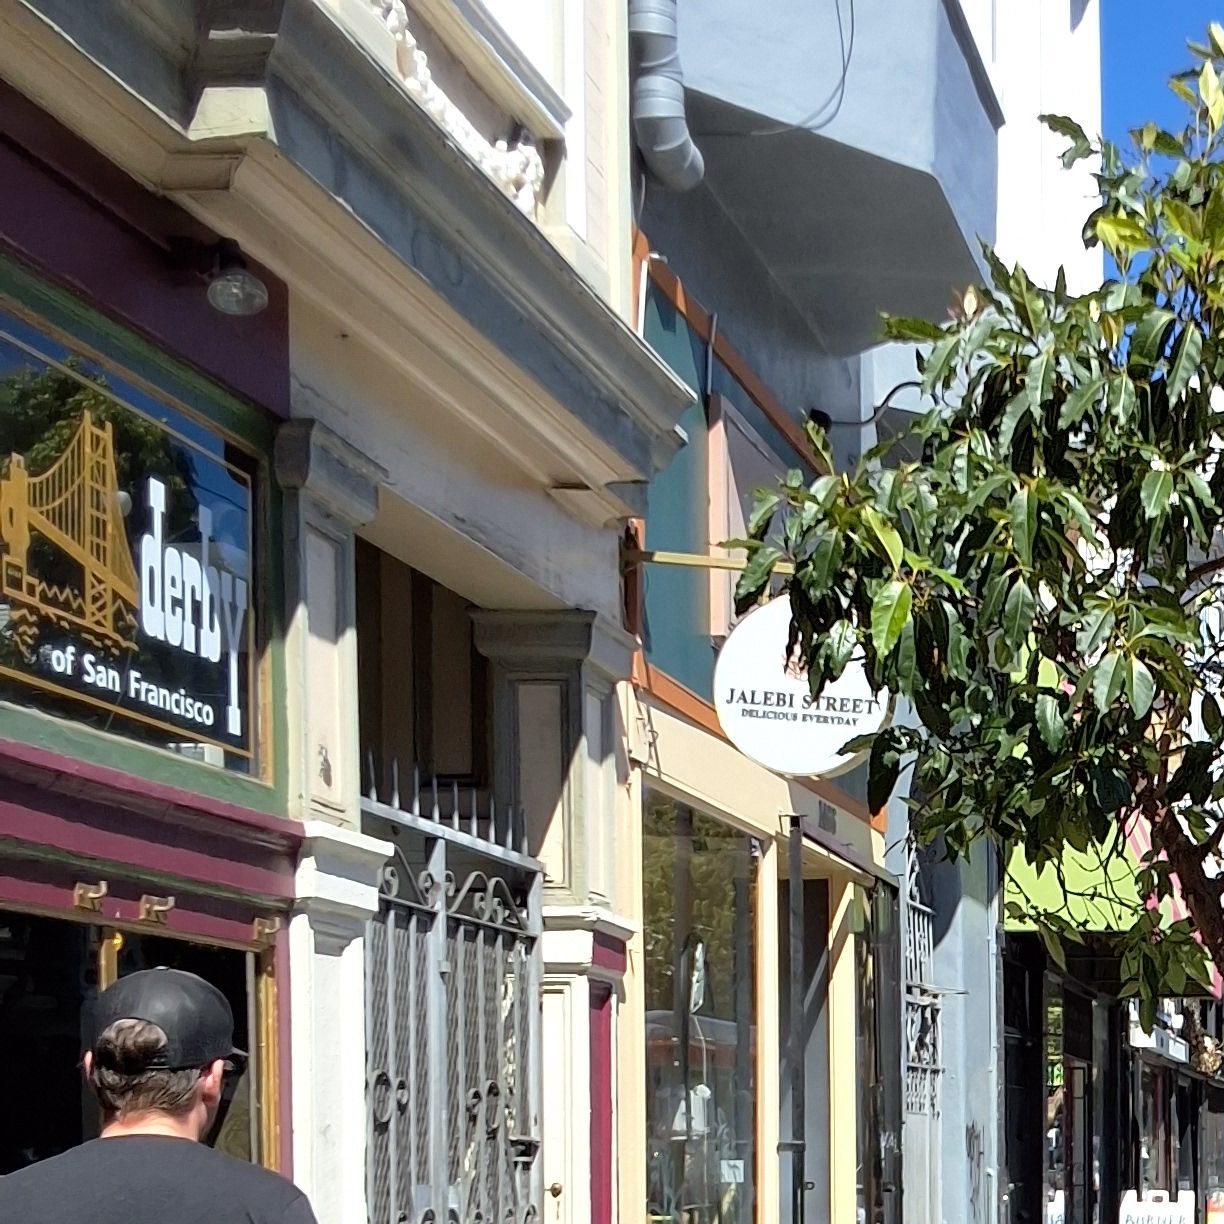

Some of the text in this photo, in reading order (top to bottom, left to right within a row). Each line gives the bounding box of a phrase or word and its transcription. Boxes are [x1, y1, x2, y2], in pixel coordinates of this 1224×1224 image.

[51, 647, 214, 726] of San Francisco
[726, 688, 876, 715] JALEBI STREET
[741, 708, 859, 727] DELICIOUS EVERYDAY
